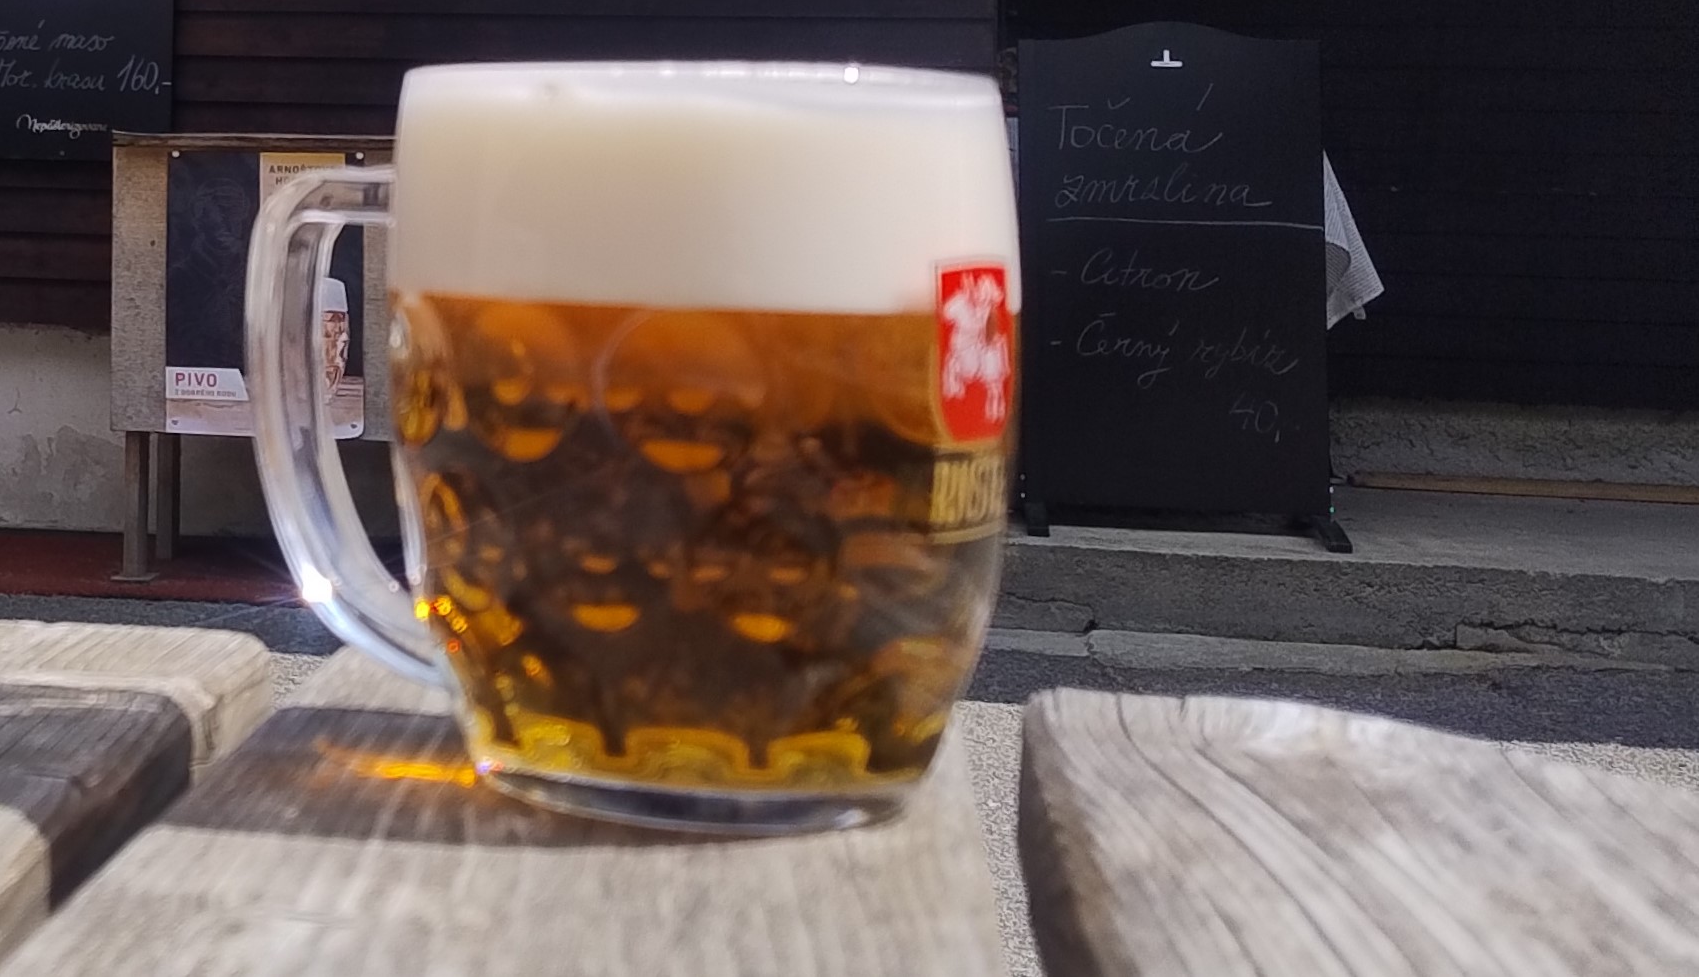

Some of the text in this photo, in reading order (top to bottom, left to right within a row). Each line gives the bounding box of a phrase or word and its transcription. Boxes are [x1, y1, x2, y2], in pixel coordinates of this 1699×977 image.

[49, 33, 116, 52] maso
[116, 54, 172, 95] 160,-
[1048, 83, 1223, 153] Točená
[1080, 248, 1220, 291] Citron
[1077, 312, 1179, 389] Černý
[174, 372, 218, 388] PIVO
